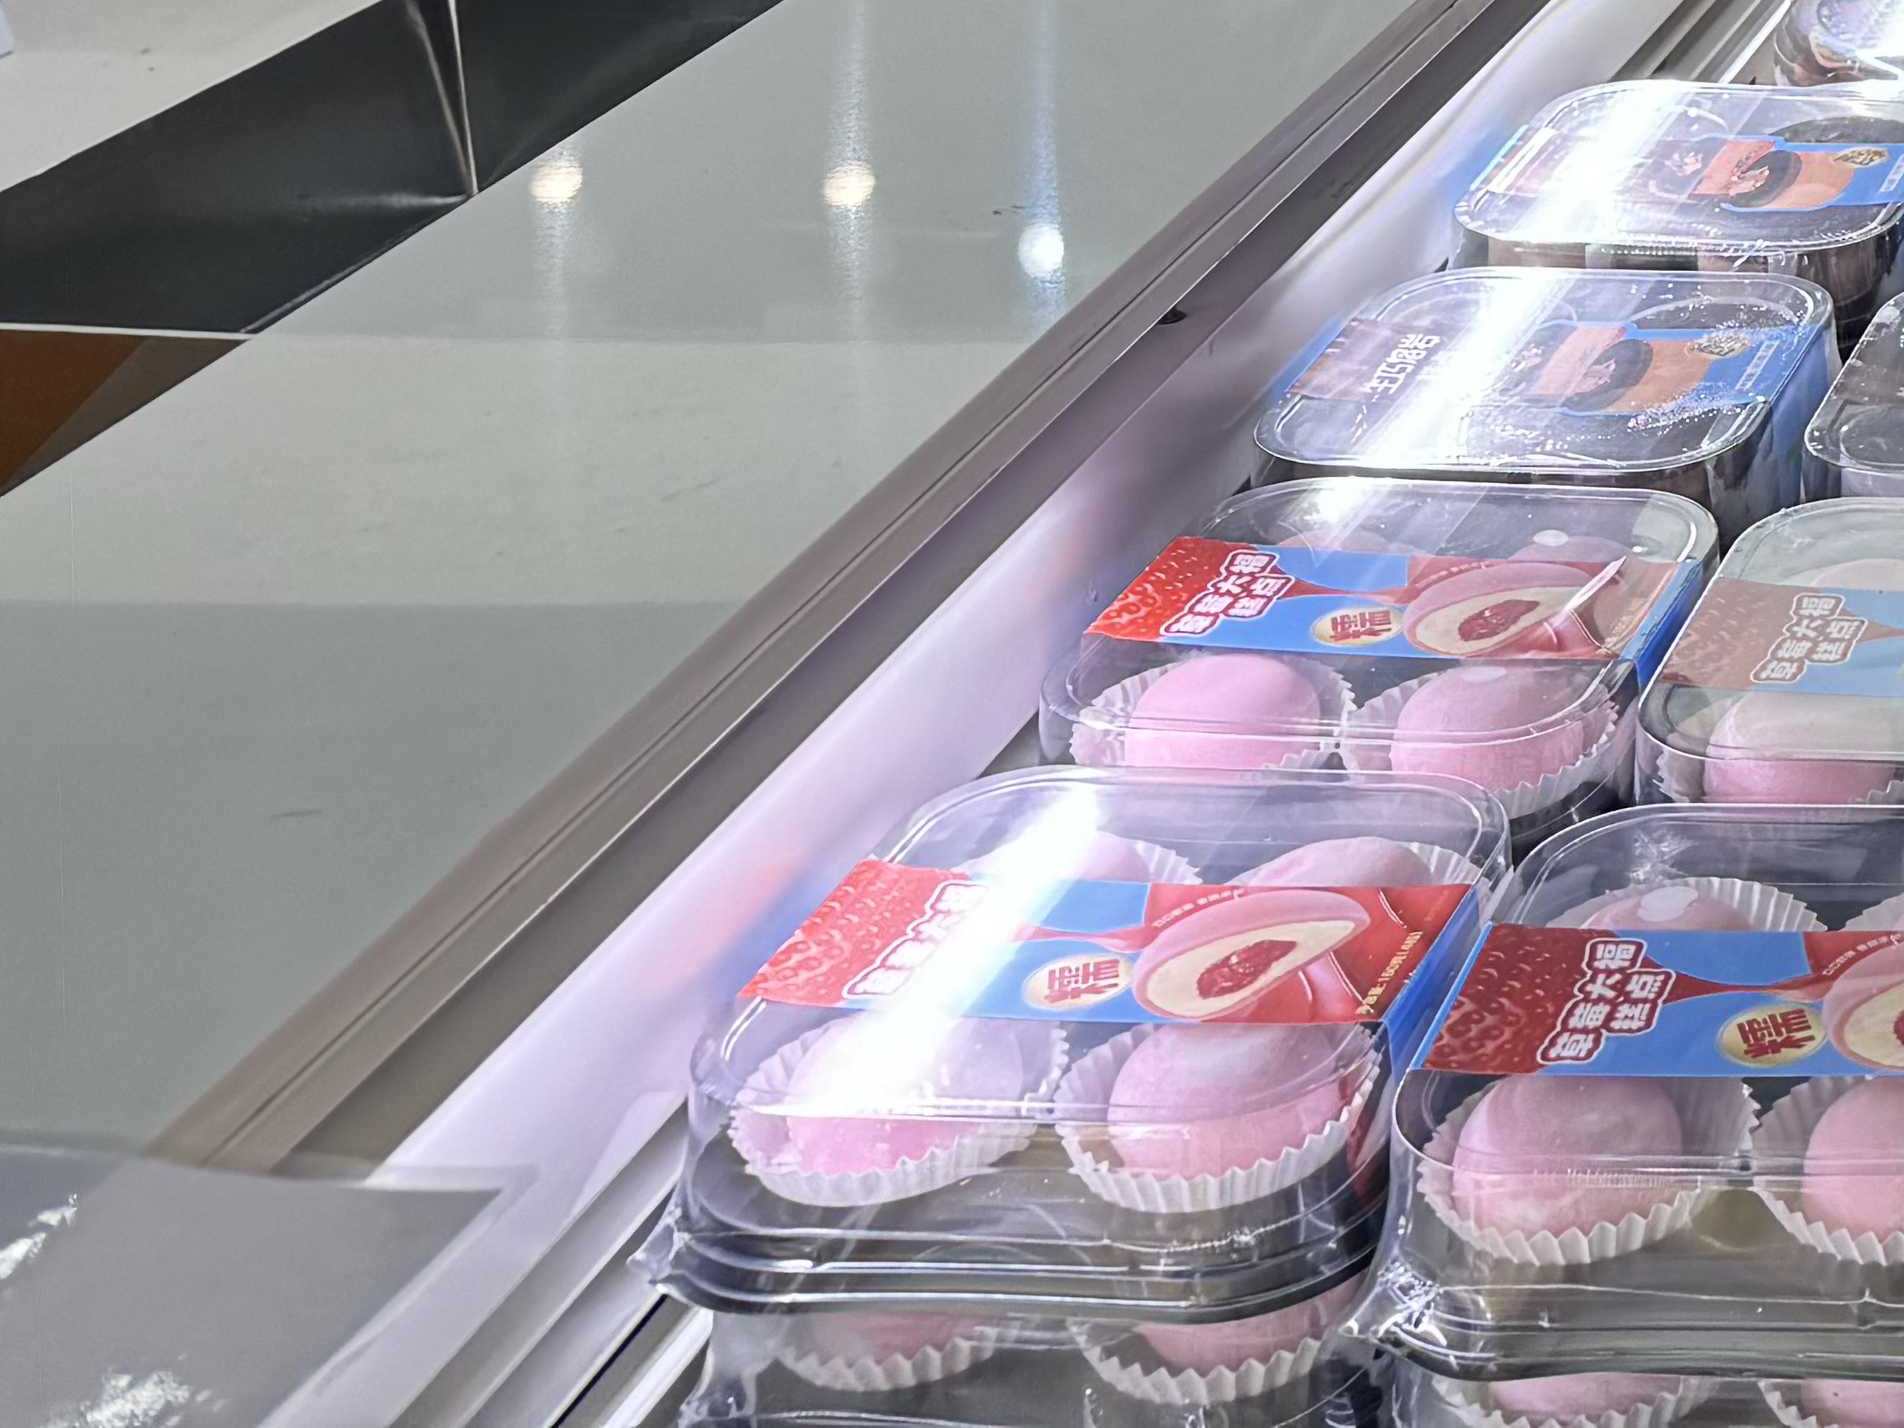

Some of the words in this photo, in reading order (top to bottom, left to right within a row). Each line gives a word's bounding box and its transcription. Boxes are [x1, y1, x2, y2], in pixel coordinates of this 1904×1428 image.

[1168, 552, 1274, 634] 草莓大福
[1229, 576, 1291, 617] 糕点
[1546, 942, 1639, 1060] 草莓大福
[1614, 975, 1667, 1029] 糕点
